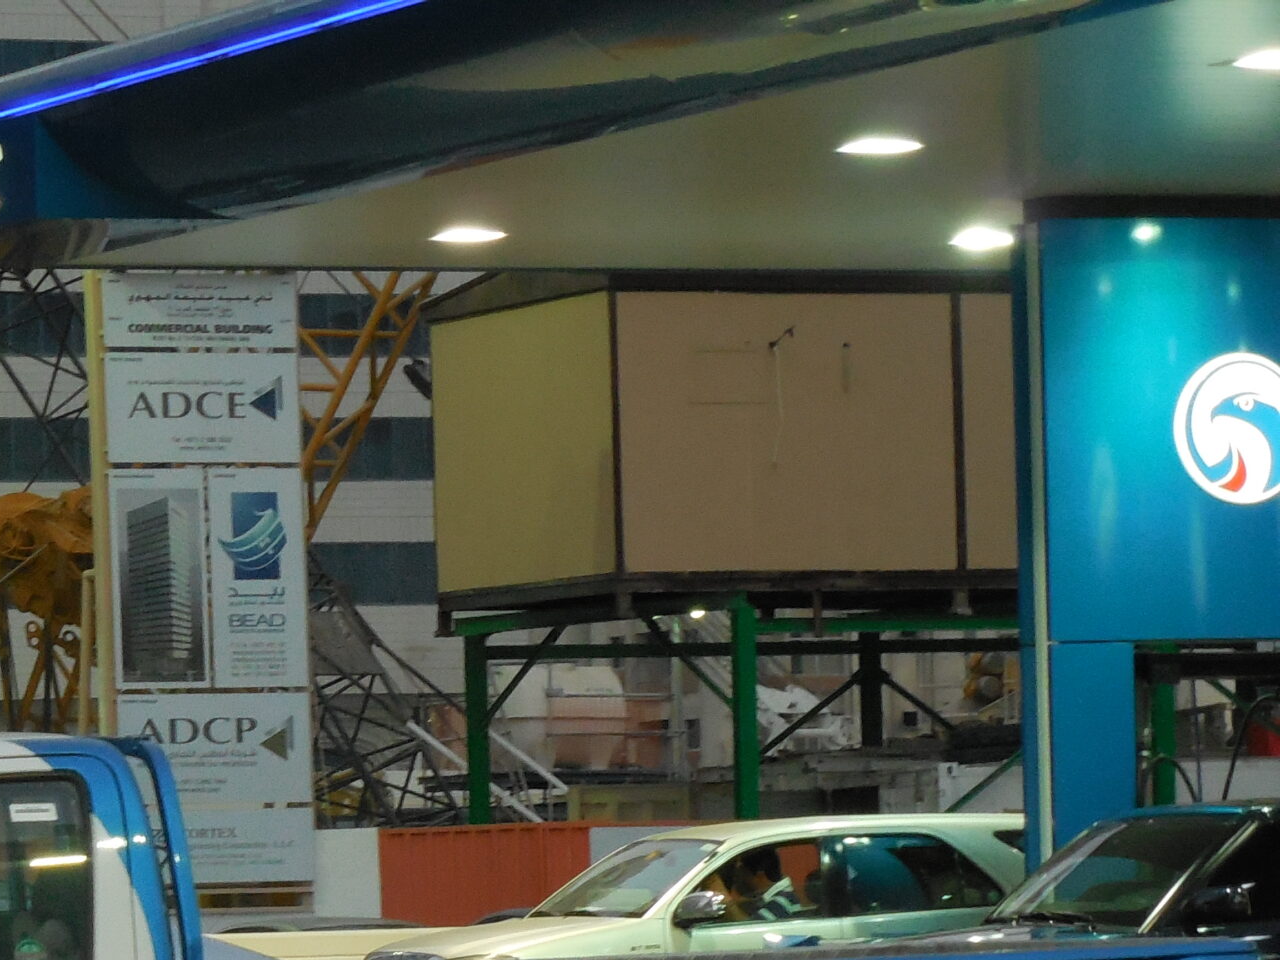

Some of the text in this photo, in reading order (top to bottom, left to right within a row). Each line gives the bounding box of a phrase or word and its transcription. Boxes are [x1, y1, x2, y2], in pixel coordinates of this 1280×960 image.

[127, 323, 274, 335] COMMERCIAL BUILDING
[128, 391, 247, 419] ADCE
[228, 613, 287, 628] BEAD
[139, 717, 259, 745] ADCP
[185, 826, 238, 839] ORTEX
